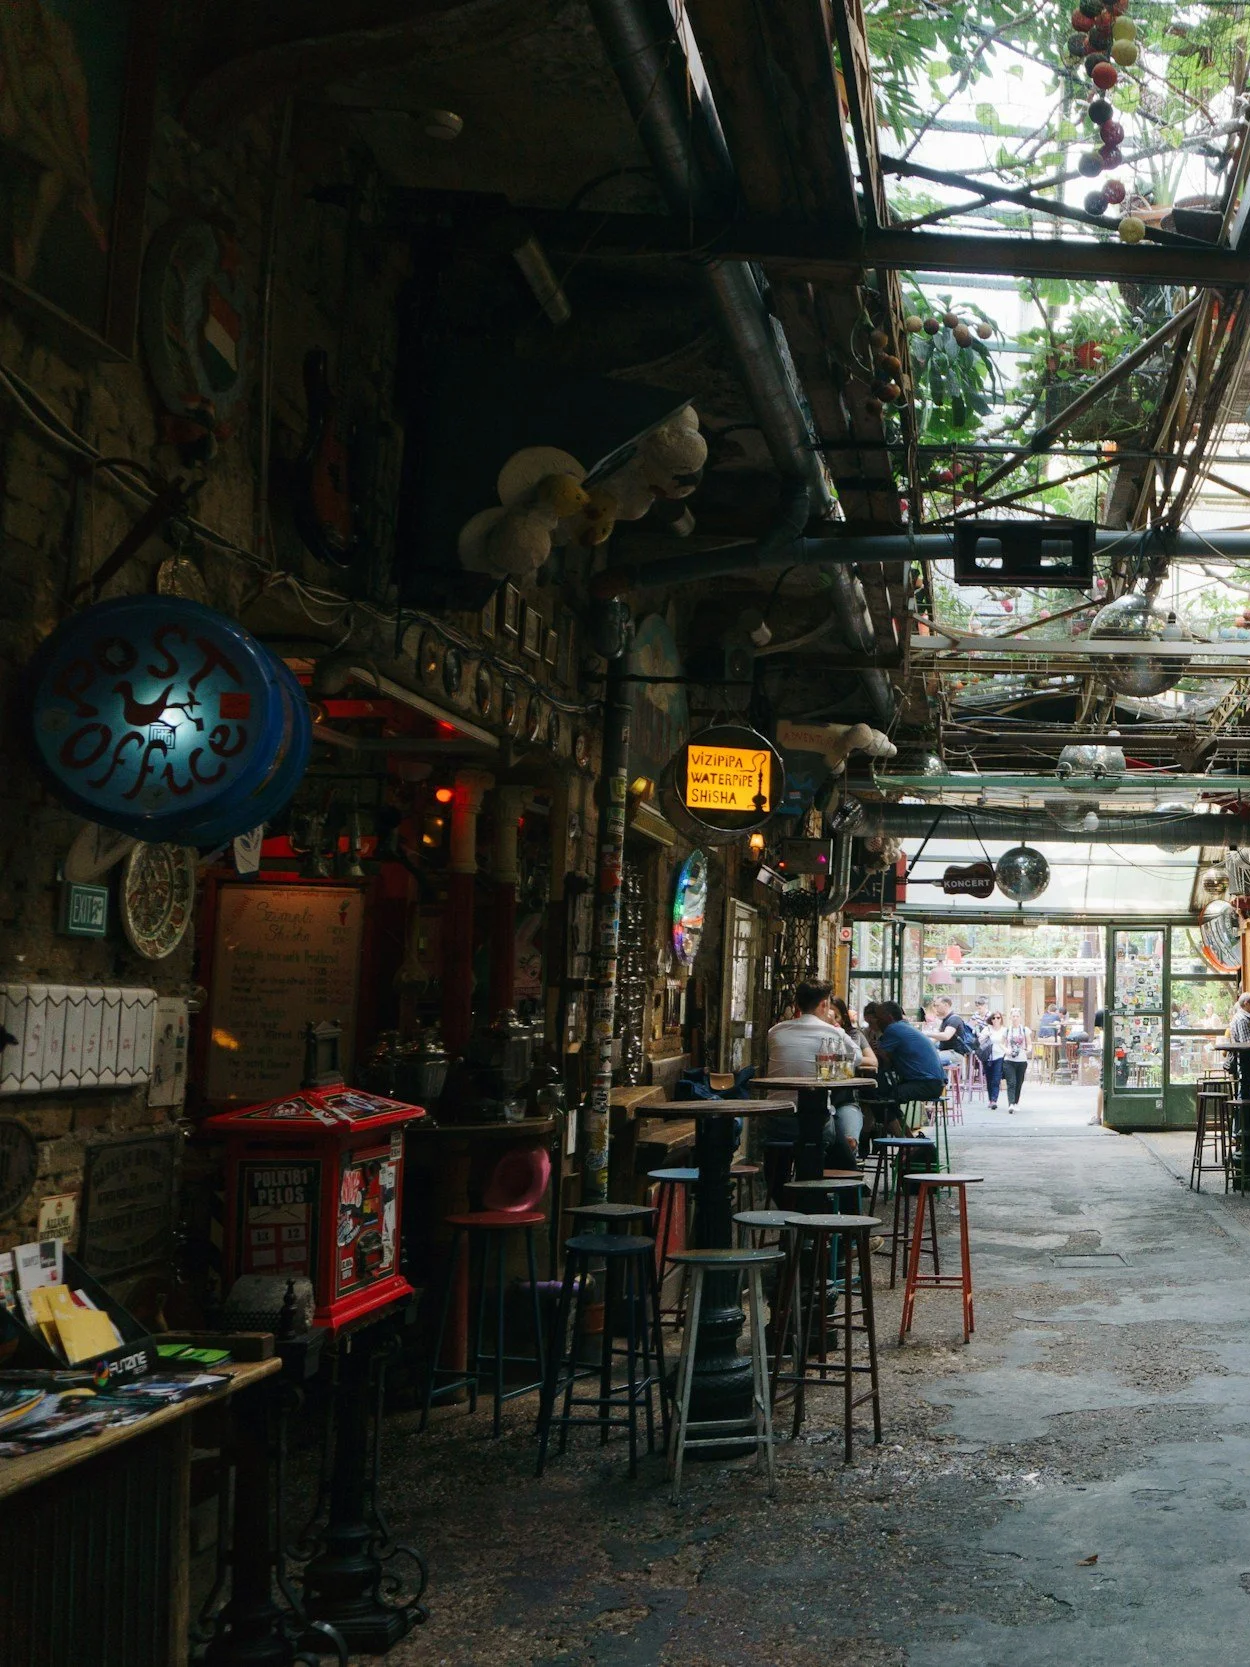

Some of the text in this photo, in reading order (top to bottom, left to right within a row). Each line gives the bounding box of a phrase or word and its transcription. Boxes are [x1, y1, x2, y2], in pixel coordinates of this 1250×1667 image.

[53, 624, 243, 718] POST
[944, 878, 990, 889] KONCERT
[73, 894, 93, 924] EXIT
